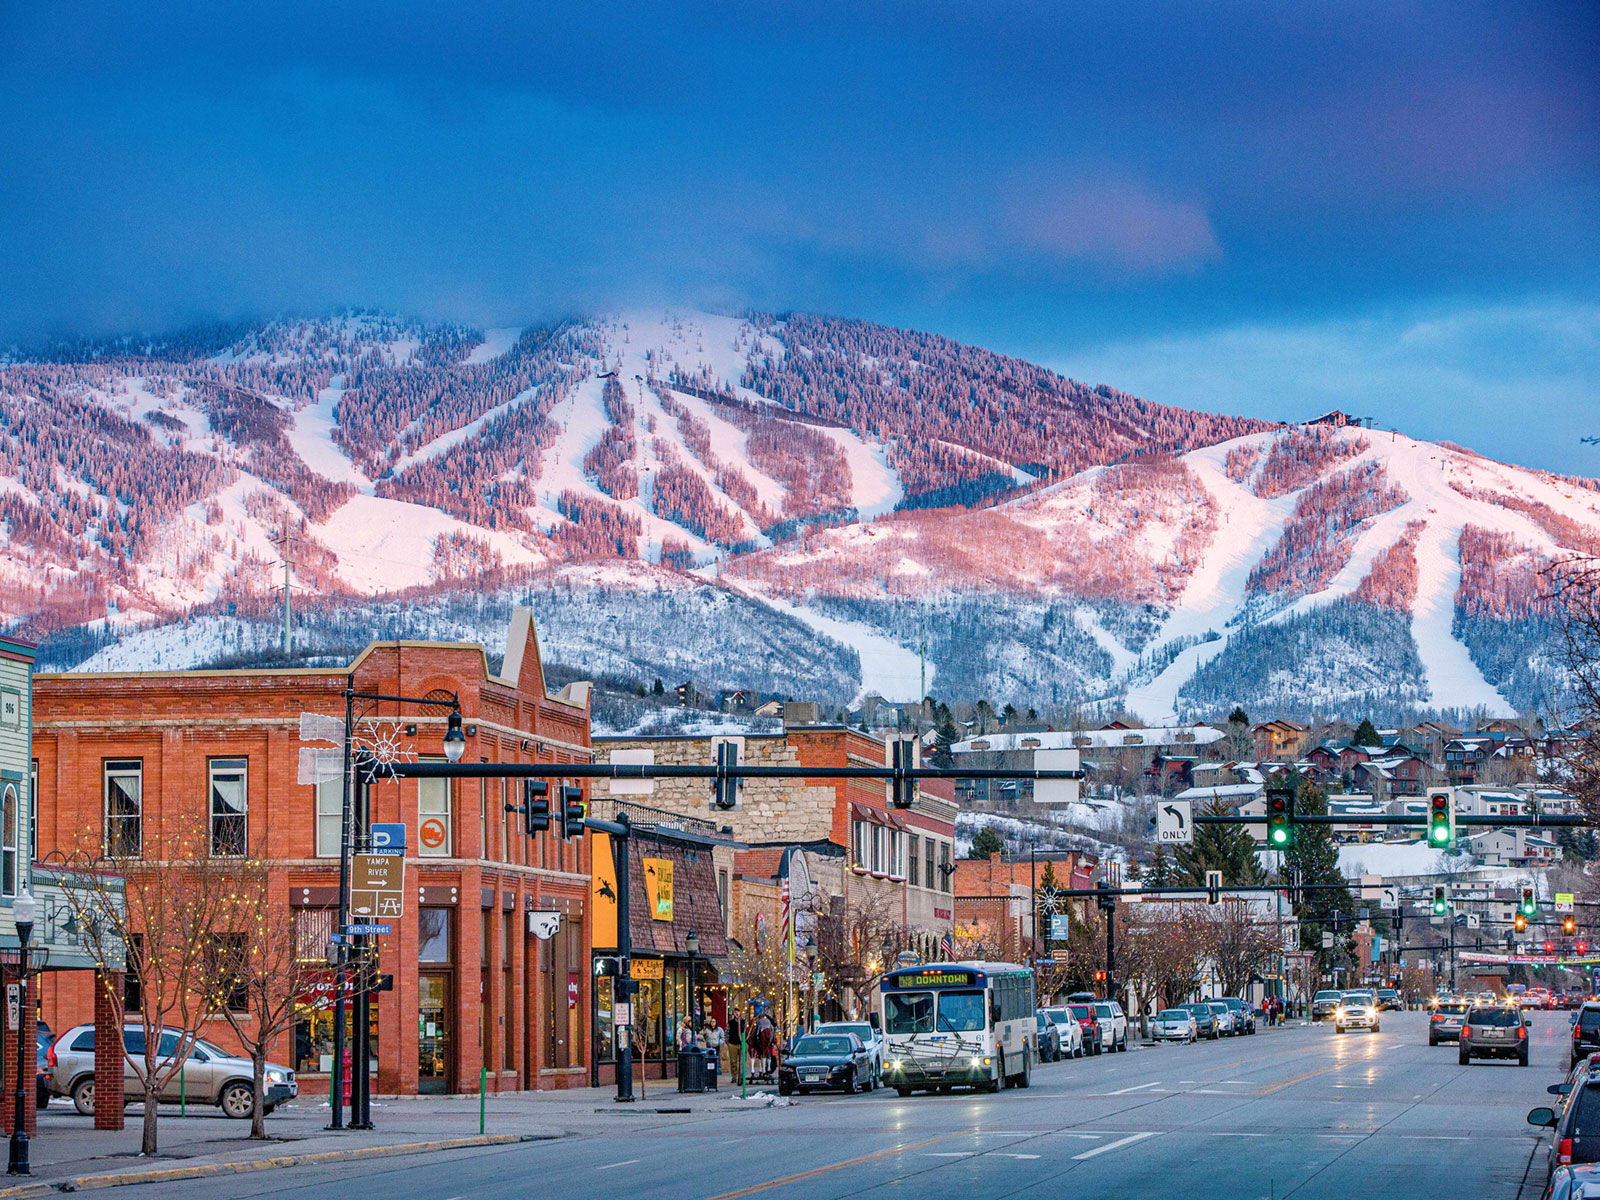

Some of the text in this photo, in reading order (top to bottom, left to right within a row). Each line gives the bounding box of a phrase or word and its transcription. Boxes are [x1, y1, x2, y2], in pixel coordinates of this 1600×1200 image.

[1162, 831, 1187, 839] ONLY
[916, 973, 968, 984] DOWNTOWN
[976, 1034, 985, 1042] 61
